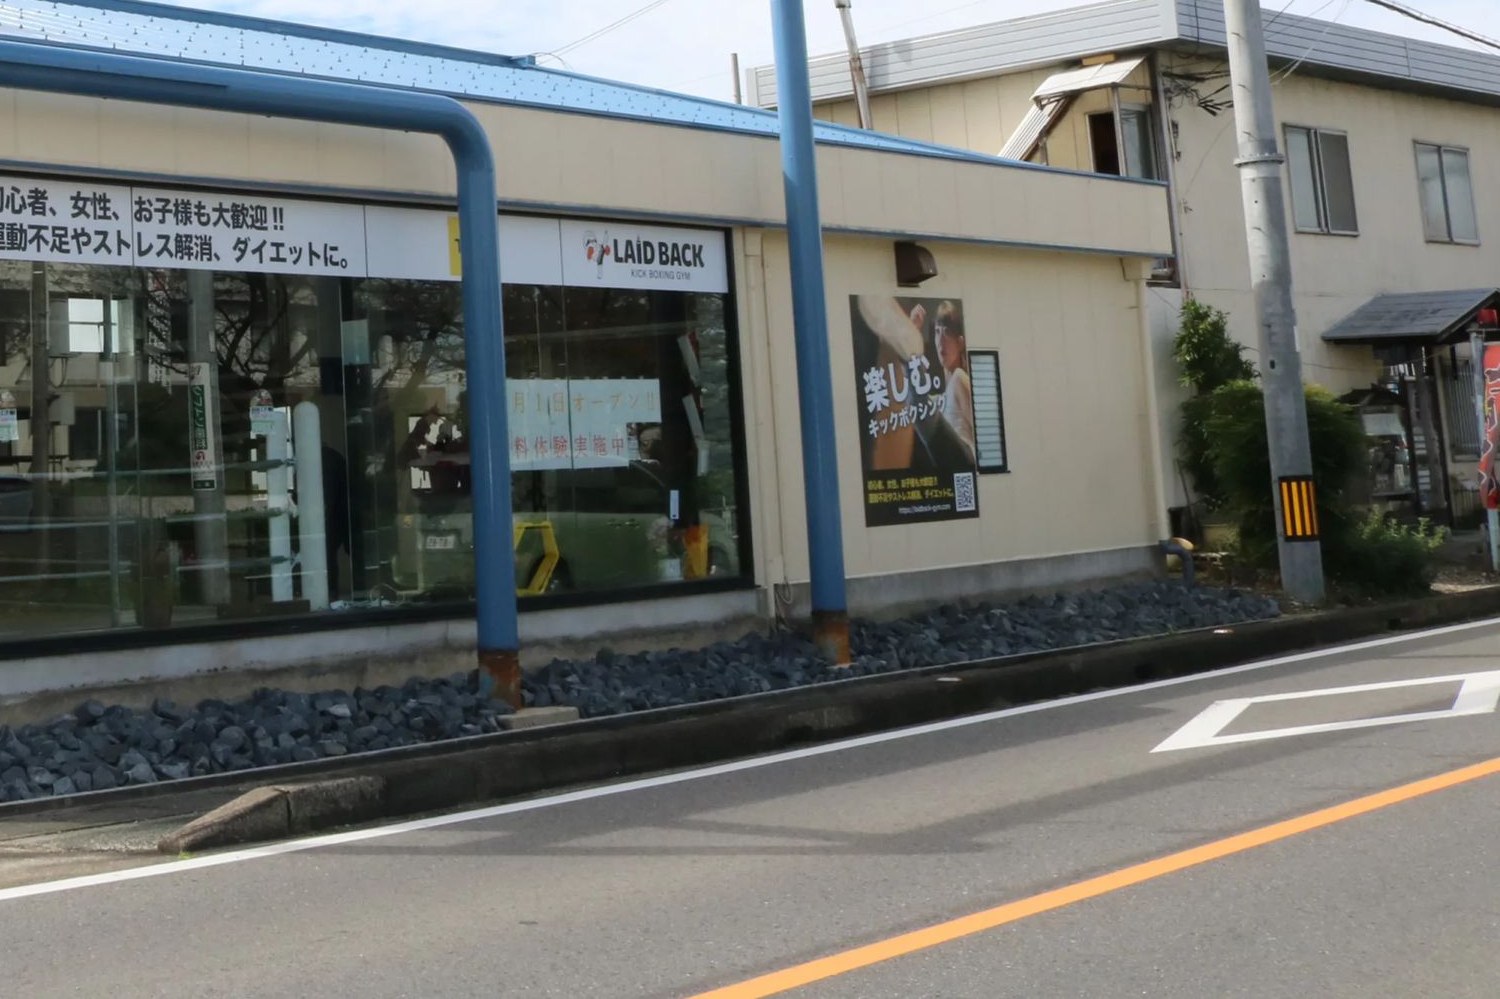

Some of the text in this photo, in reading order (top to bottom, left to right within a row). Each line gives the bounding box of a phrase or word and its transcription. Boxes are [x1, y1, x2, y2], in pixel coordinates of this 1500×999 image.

[613, 237, 705, 268] LAID BACK
[631, 269, 691, 281] KICK BOXING GYM
[863, 355, 941, 413] 楽しむ。
[868, 392, 947, 438] キックボクシング
[514, 433, 624, 458] 料体験実施中
